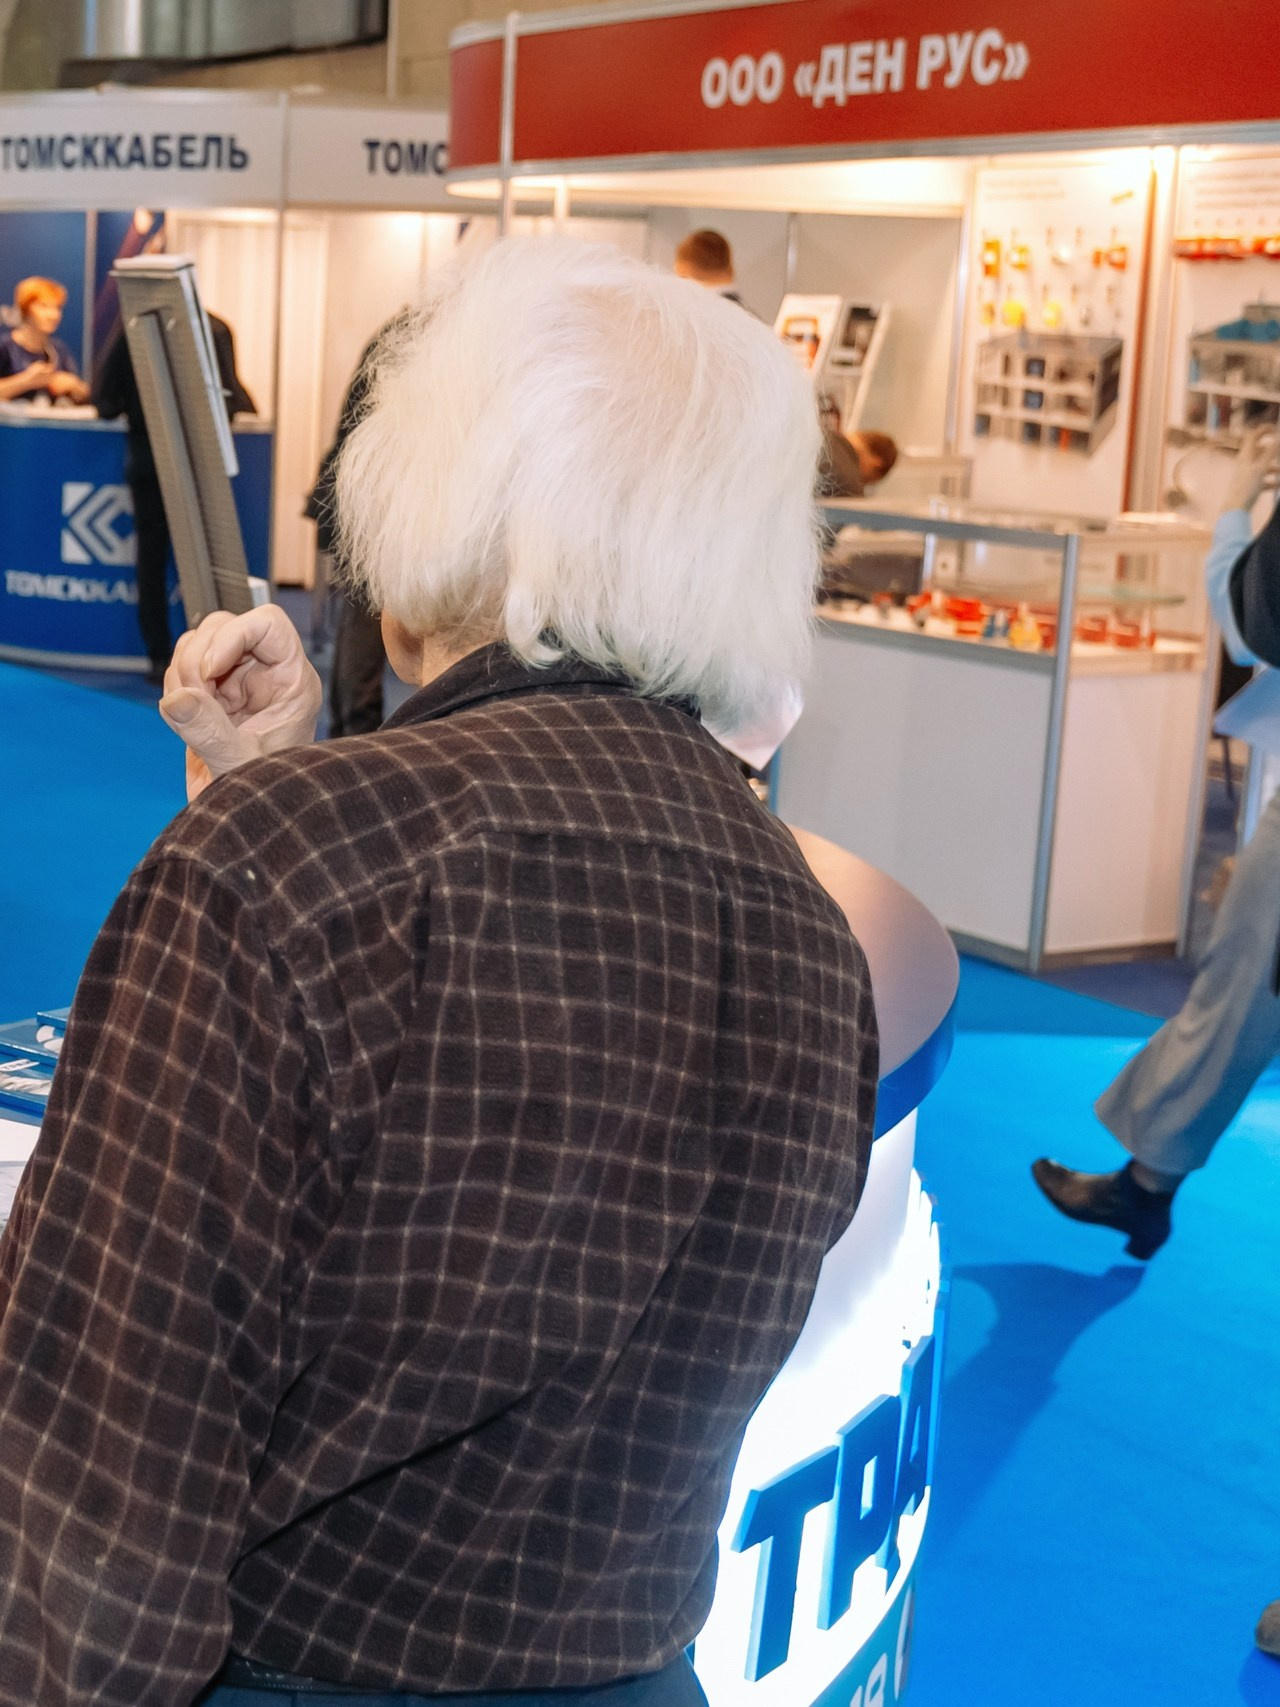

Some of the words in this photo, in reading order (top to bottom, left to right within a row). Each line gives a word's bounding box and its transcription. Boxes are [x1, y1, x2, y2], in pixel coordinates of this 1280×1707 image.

[701, 52, 785, 109] ООО
[793, 38, 907, 109] «ДЕН
[916, 27, 1030, 90] РУС»
[0, 133, 249, 171] ТОМСККАБЕЛЬ
